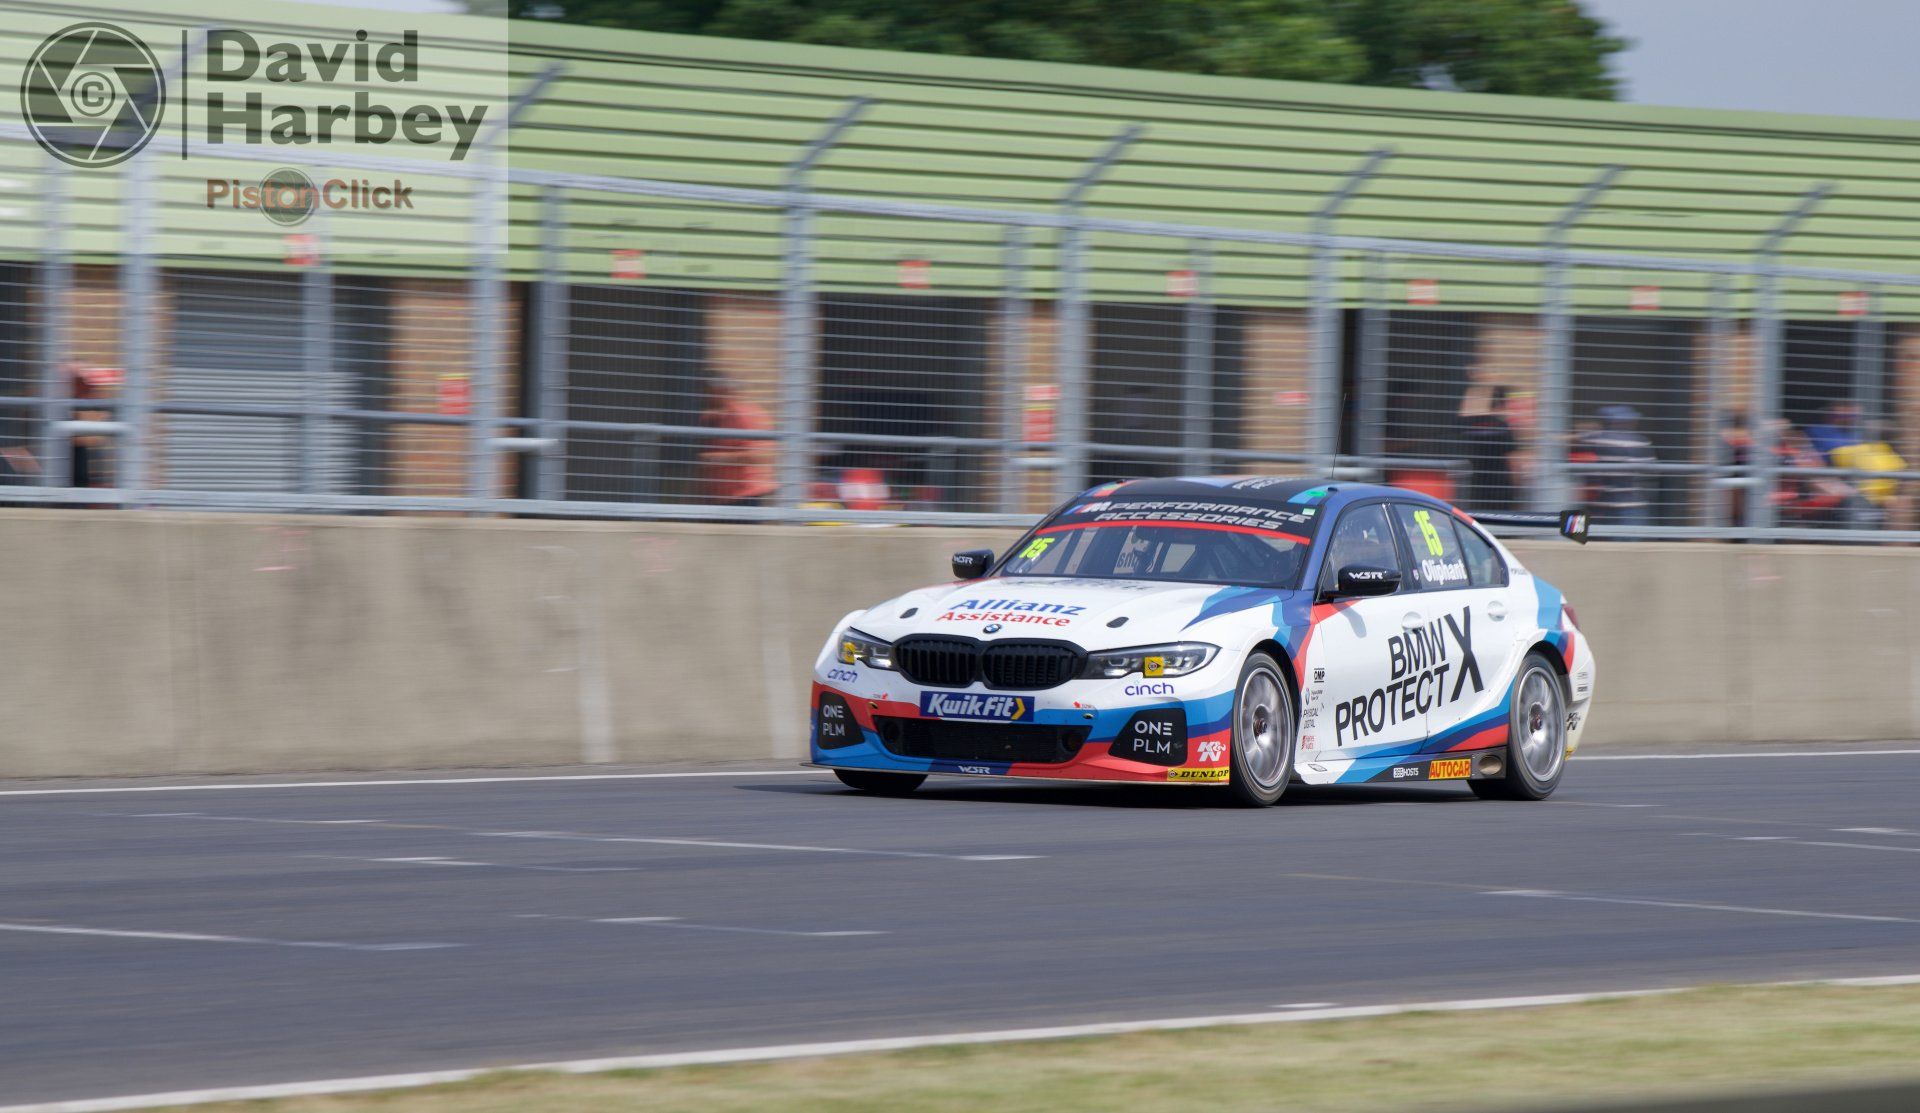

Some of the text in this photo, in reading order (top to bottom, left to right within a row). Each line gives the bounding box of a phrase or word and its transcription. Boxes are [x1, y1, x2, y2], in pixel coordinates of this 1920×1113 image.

[1094, 512, 1283, 530] ACCESSORIES
[1414, 510, 1444, 556] 15
[1019, 537, 1055, 559] 15
[1421, 559, 1468, 586] Oliphant
[950, 599, 1088, 616] Allianz
[936, 612, 1071, 627] Assistance
[1387, 617, 1446, 681] BMW
[1124, 682, 1175, 696] cinch
[822, 704, 845, 719] ONE
[1335, 663, 1450, 747] PROTECT
[822, 722, 846, 737] PLM
[1134, 720, 1173, 736] ONE
[1133, 738, 1171, 754] PLM
[1180, 769, 1229, 778] DUNLOP
[1429, 761, 1470, 779] AUTOCAR
